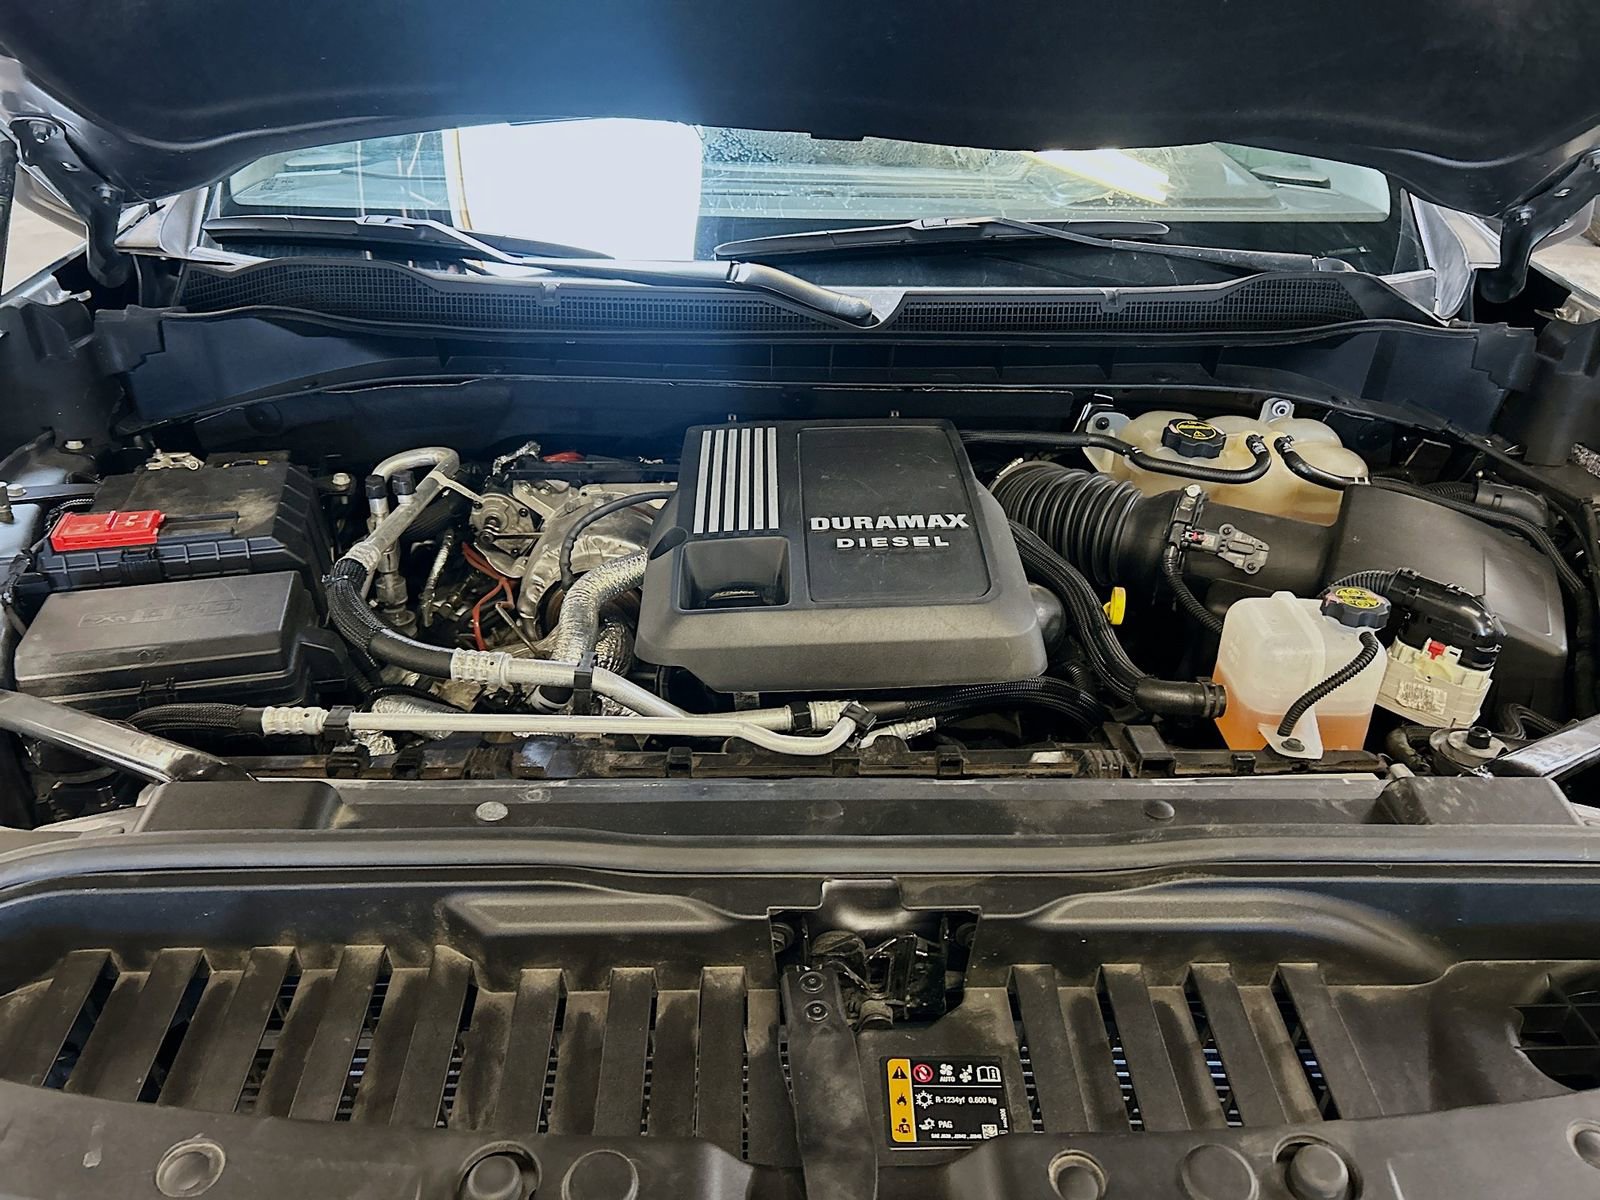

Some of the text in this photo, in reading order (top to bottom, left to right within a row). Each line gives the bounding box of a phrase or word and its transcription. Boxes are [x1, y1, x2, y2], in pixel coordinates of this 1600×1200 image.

[810, 514, 970, 531] DURAMAX
[836, 536, 950, 549] DIESEL
[935, 1096, 965, 1105] R-1234yf
[987, 1096, 998, 1105] kg
[938, 1120, 953, 1128] PAG
